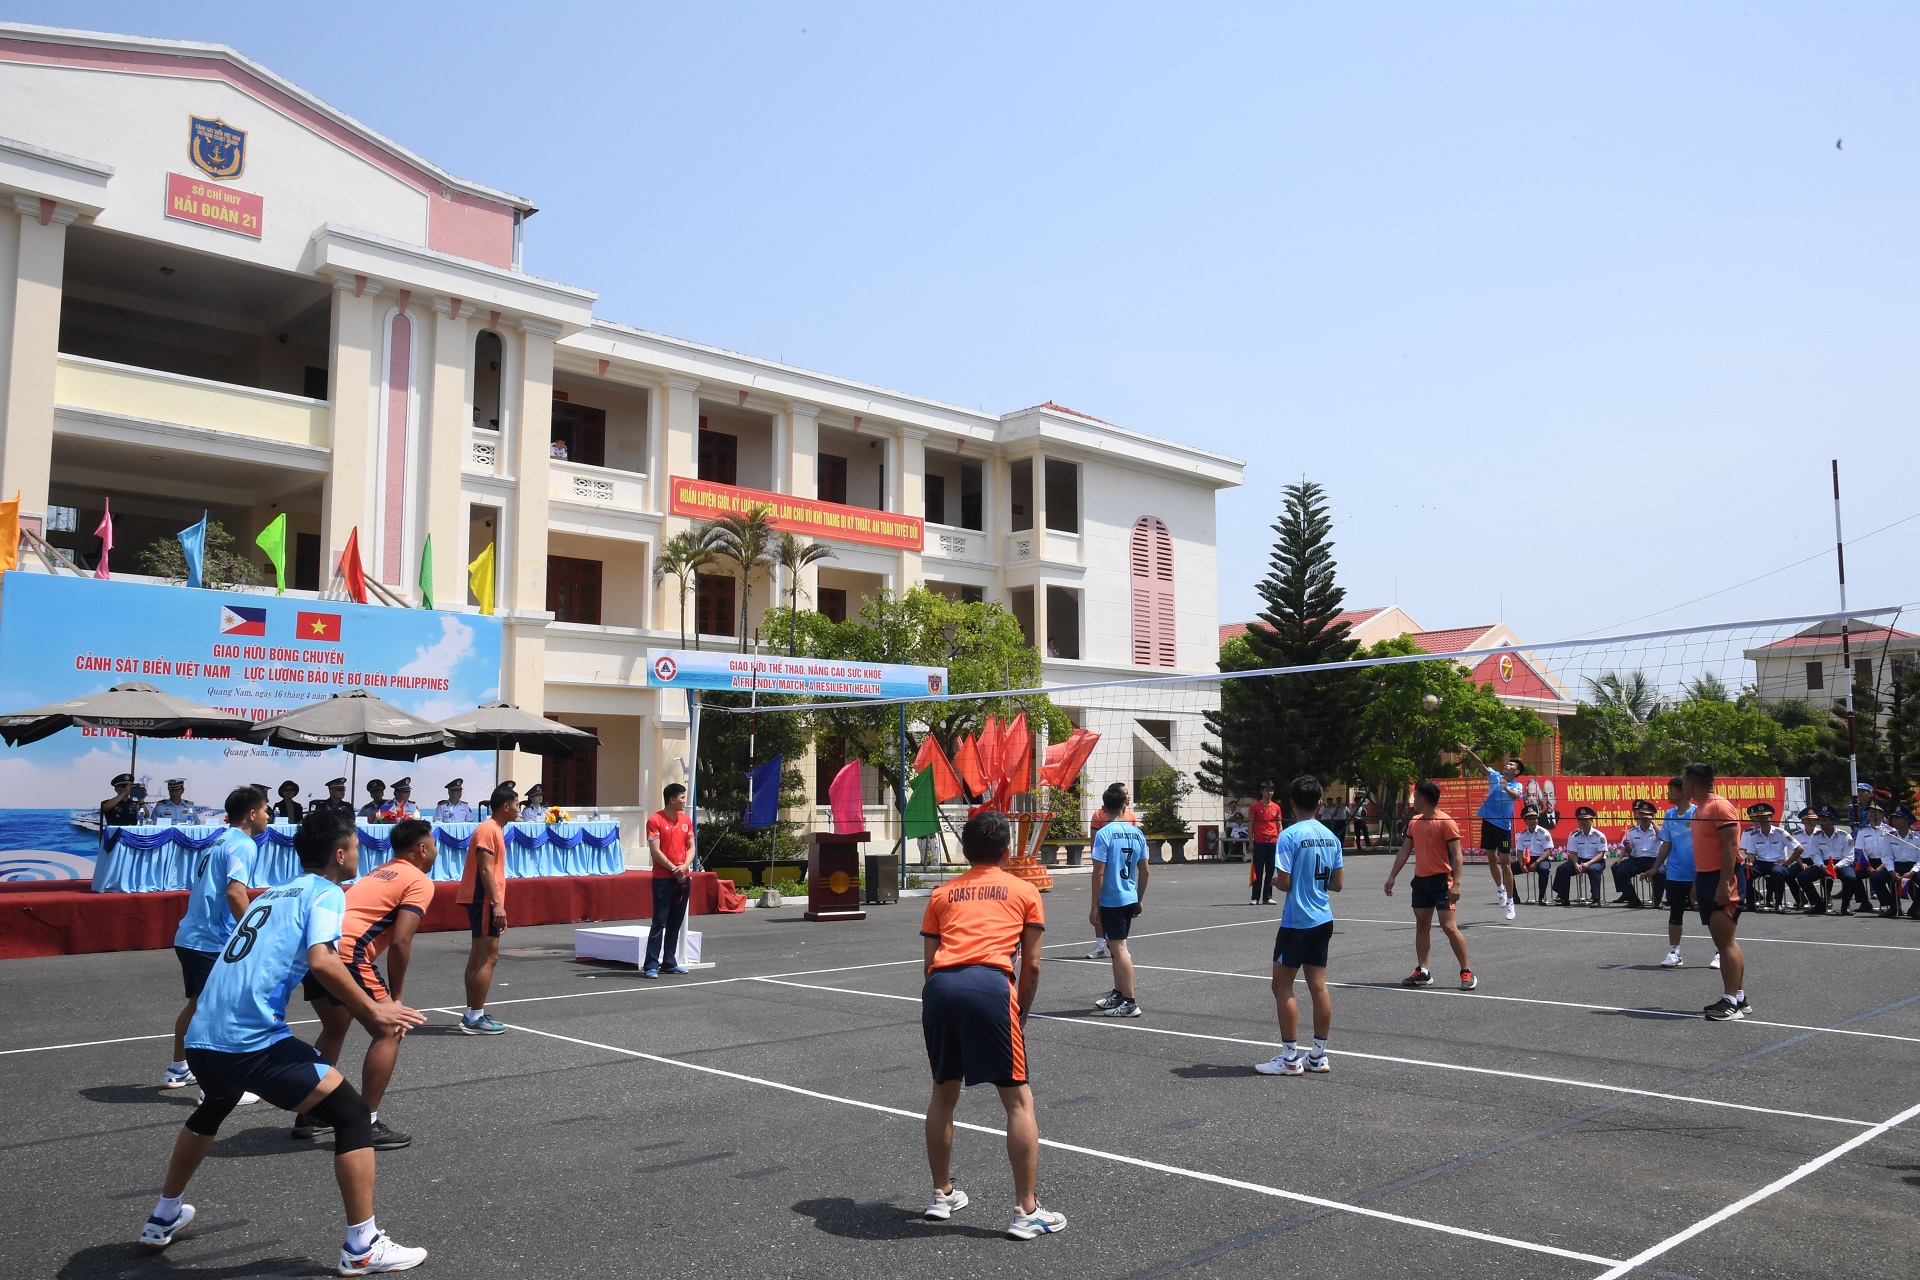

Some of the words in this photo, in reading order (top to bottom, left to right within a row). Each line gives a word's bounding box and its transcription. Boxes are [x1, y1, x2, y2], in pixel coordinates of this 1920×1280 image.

[192, 185, 204, 196] SỞ
[207, 190, 221, 200] CHỈ
[224, 194, 241, 205] HUY
[174, 195, 197, 214] HẢI
[202, 203, 238, 224] ĐOÀN
[242, 214, 256, 228] 21
[680, 485, 696, 504] HUẤN
[699, 490, 716, 510] LUYỆN
[780, 503, 792, 519] LÀM
[793, 504, 804, 522] CHỦ
[814, 509, 822, 525] KHÍ
[823, 512, 839, 528] TRANG
[841, 515, 847, 531] BỊ
[872, 520, 879, 533] AN
[880, 520, 893, 535] TOÀN
[894, 522, 909, 540] TUYỆT
[213, 644, 239, 658] GIAO
[244, 645, 266, 660] HỮU
[270, 647, 299, 661] BÓNG
[76, 652, 112, 672] CẢNH
[116, 657, 139, 673] SÁT
[143, 656, 171, 675] BIỂN
[175, 661, 200, 679] VIỆT
[203, 665, 230, 678] NAM
[244, 667, 265, 682] LỰC
[268, 668, 304, 684] LƯỢNG
[307, 667, 329, 683] BẢO
[332, 670, 344, 687] VỆ
[348, 671, 362, 685] BỜ
[364, 670, 387, 687] BIỂN
[390, 676, 449, 690] PHILIPPINES
[730, 661, 748, 671] GIAO
[769, 660, 782, 674] THỂ
[785, 664, 805, 675] THAO,
[808, 664, 829, 676] NÂNG
[831, 667, 845, 677] CAO
[848, 667, 861, 678] SỨC
[234, 688, 252, 697] Nam,
[255, 690, 271, 698] ngày
[283, 690, 304, 699] tháng
[732, 677, 738, 687] A
[740, 677, 776, 689] FRIENDLY
[779, 680, 807, 692] MATCH,
[808, 681, 814, 691] A
[816, 682, 852, 693] RESILIENT
[854, 684, 880, 694] HEALTH
[250, 748, 268, 757] Nam,
[283, 750, 304, 758] April,
[1567, 782, 1584, 801] KIÊN
[1586, 785, 1602, 804] ĐỊNH
[1605, 785, 1619, 804] MỤC
[1621, 782, 1635, 800] TIÊU
[1636, 782, 1649, 803] ĐỘC
[1651, 782, 1663, 803] LẬP
[1728, 781, 1739, 799] CHỦ
[1740, 783, 1757, 799] NGHĨA
[1758, 782, 1765, 798] XÃ
[1766, 782, 1775, 801] HỘI
[1502, 840, 1509, 848] 10
[1120, 848, 1133, 879] 3
[1315, 853, 1331, 892] 4
[948, 887, 976, 903] COAST
[978, 886, 1008, 900] GUARD
[224, 905, 272, 964] 8
